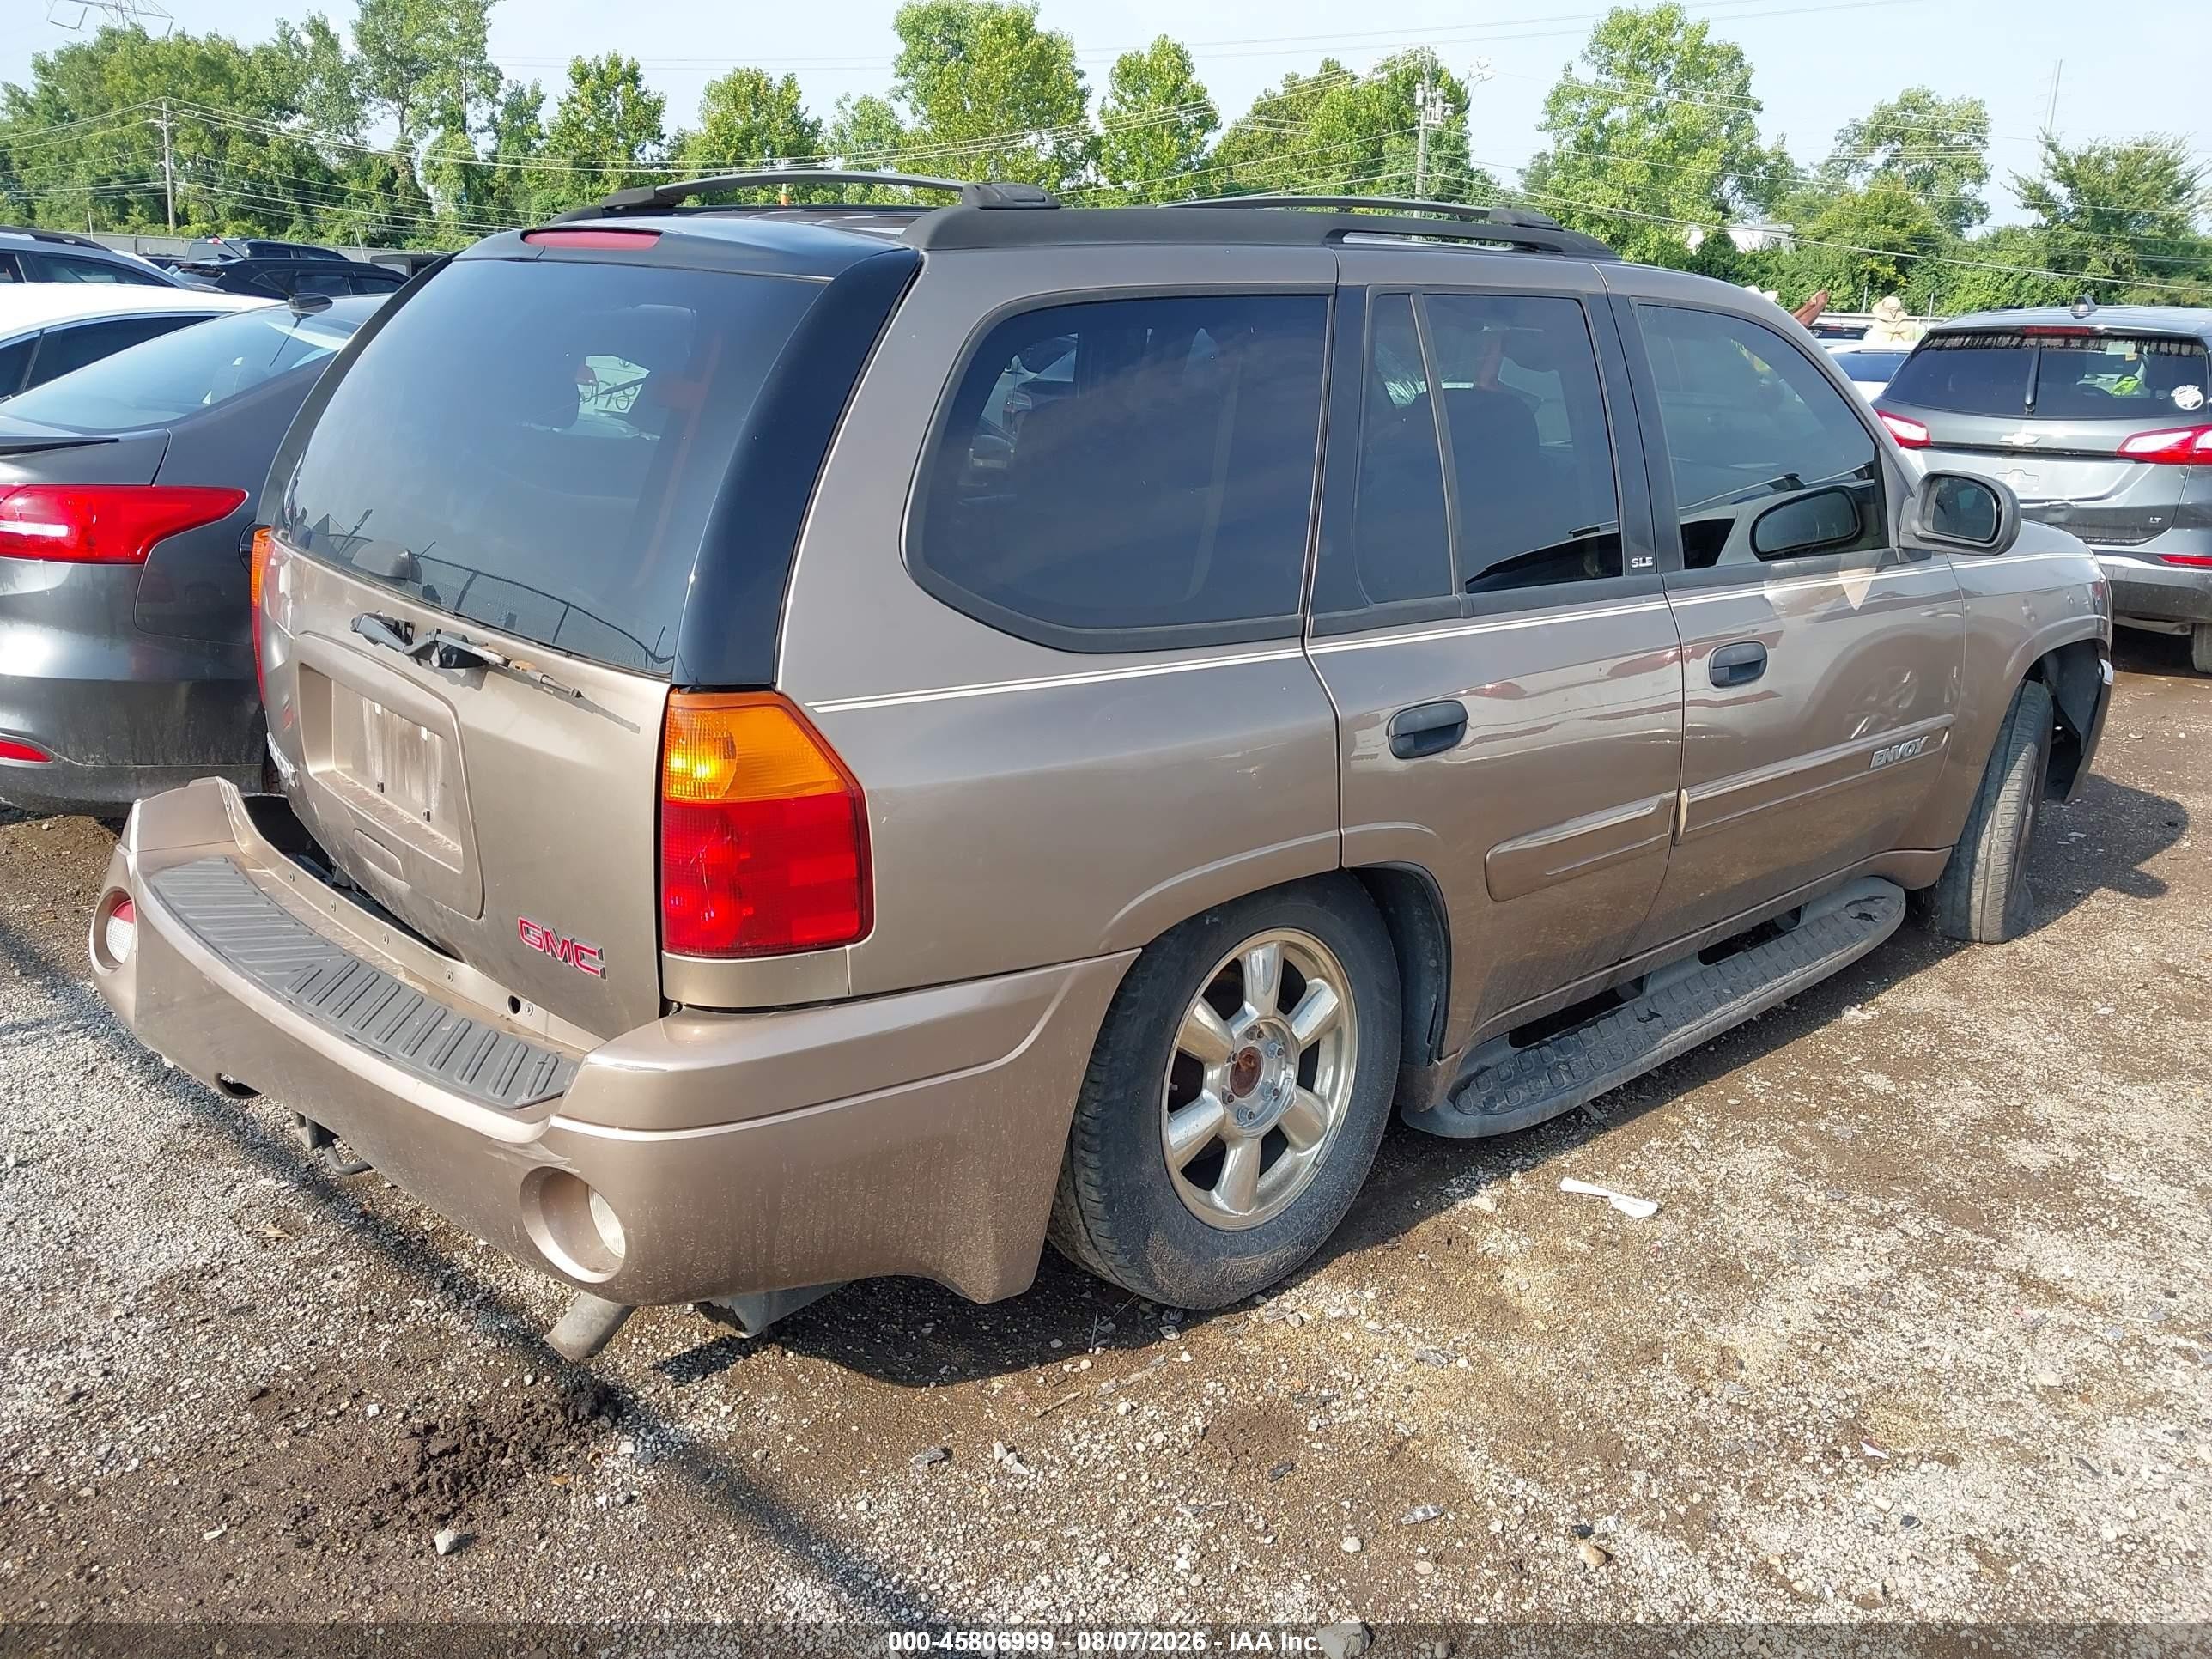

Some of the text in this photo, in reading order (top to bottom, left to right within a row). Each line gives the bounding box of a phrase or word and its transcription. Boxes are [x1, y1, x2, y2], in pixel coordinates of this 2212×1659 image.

[1631, 556, 1654, 568] SLE
[1870, 735, 1929, 769] ENVOY
[517, 915, 607, 981] GMC
